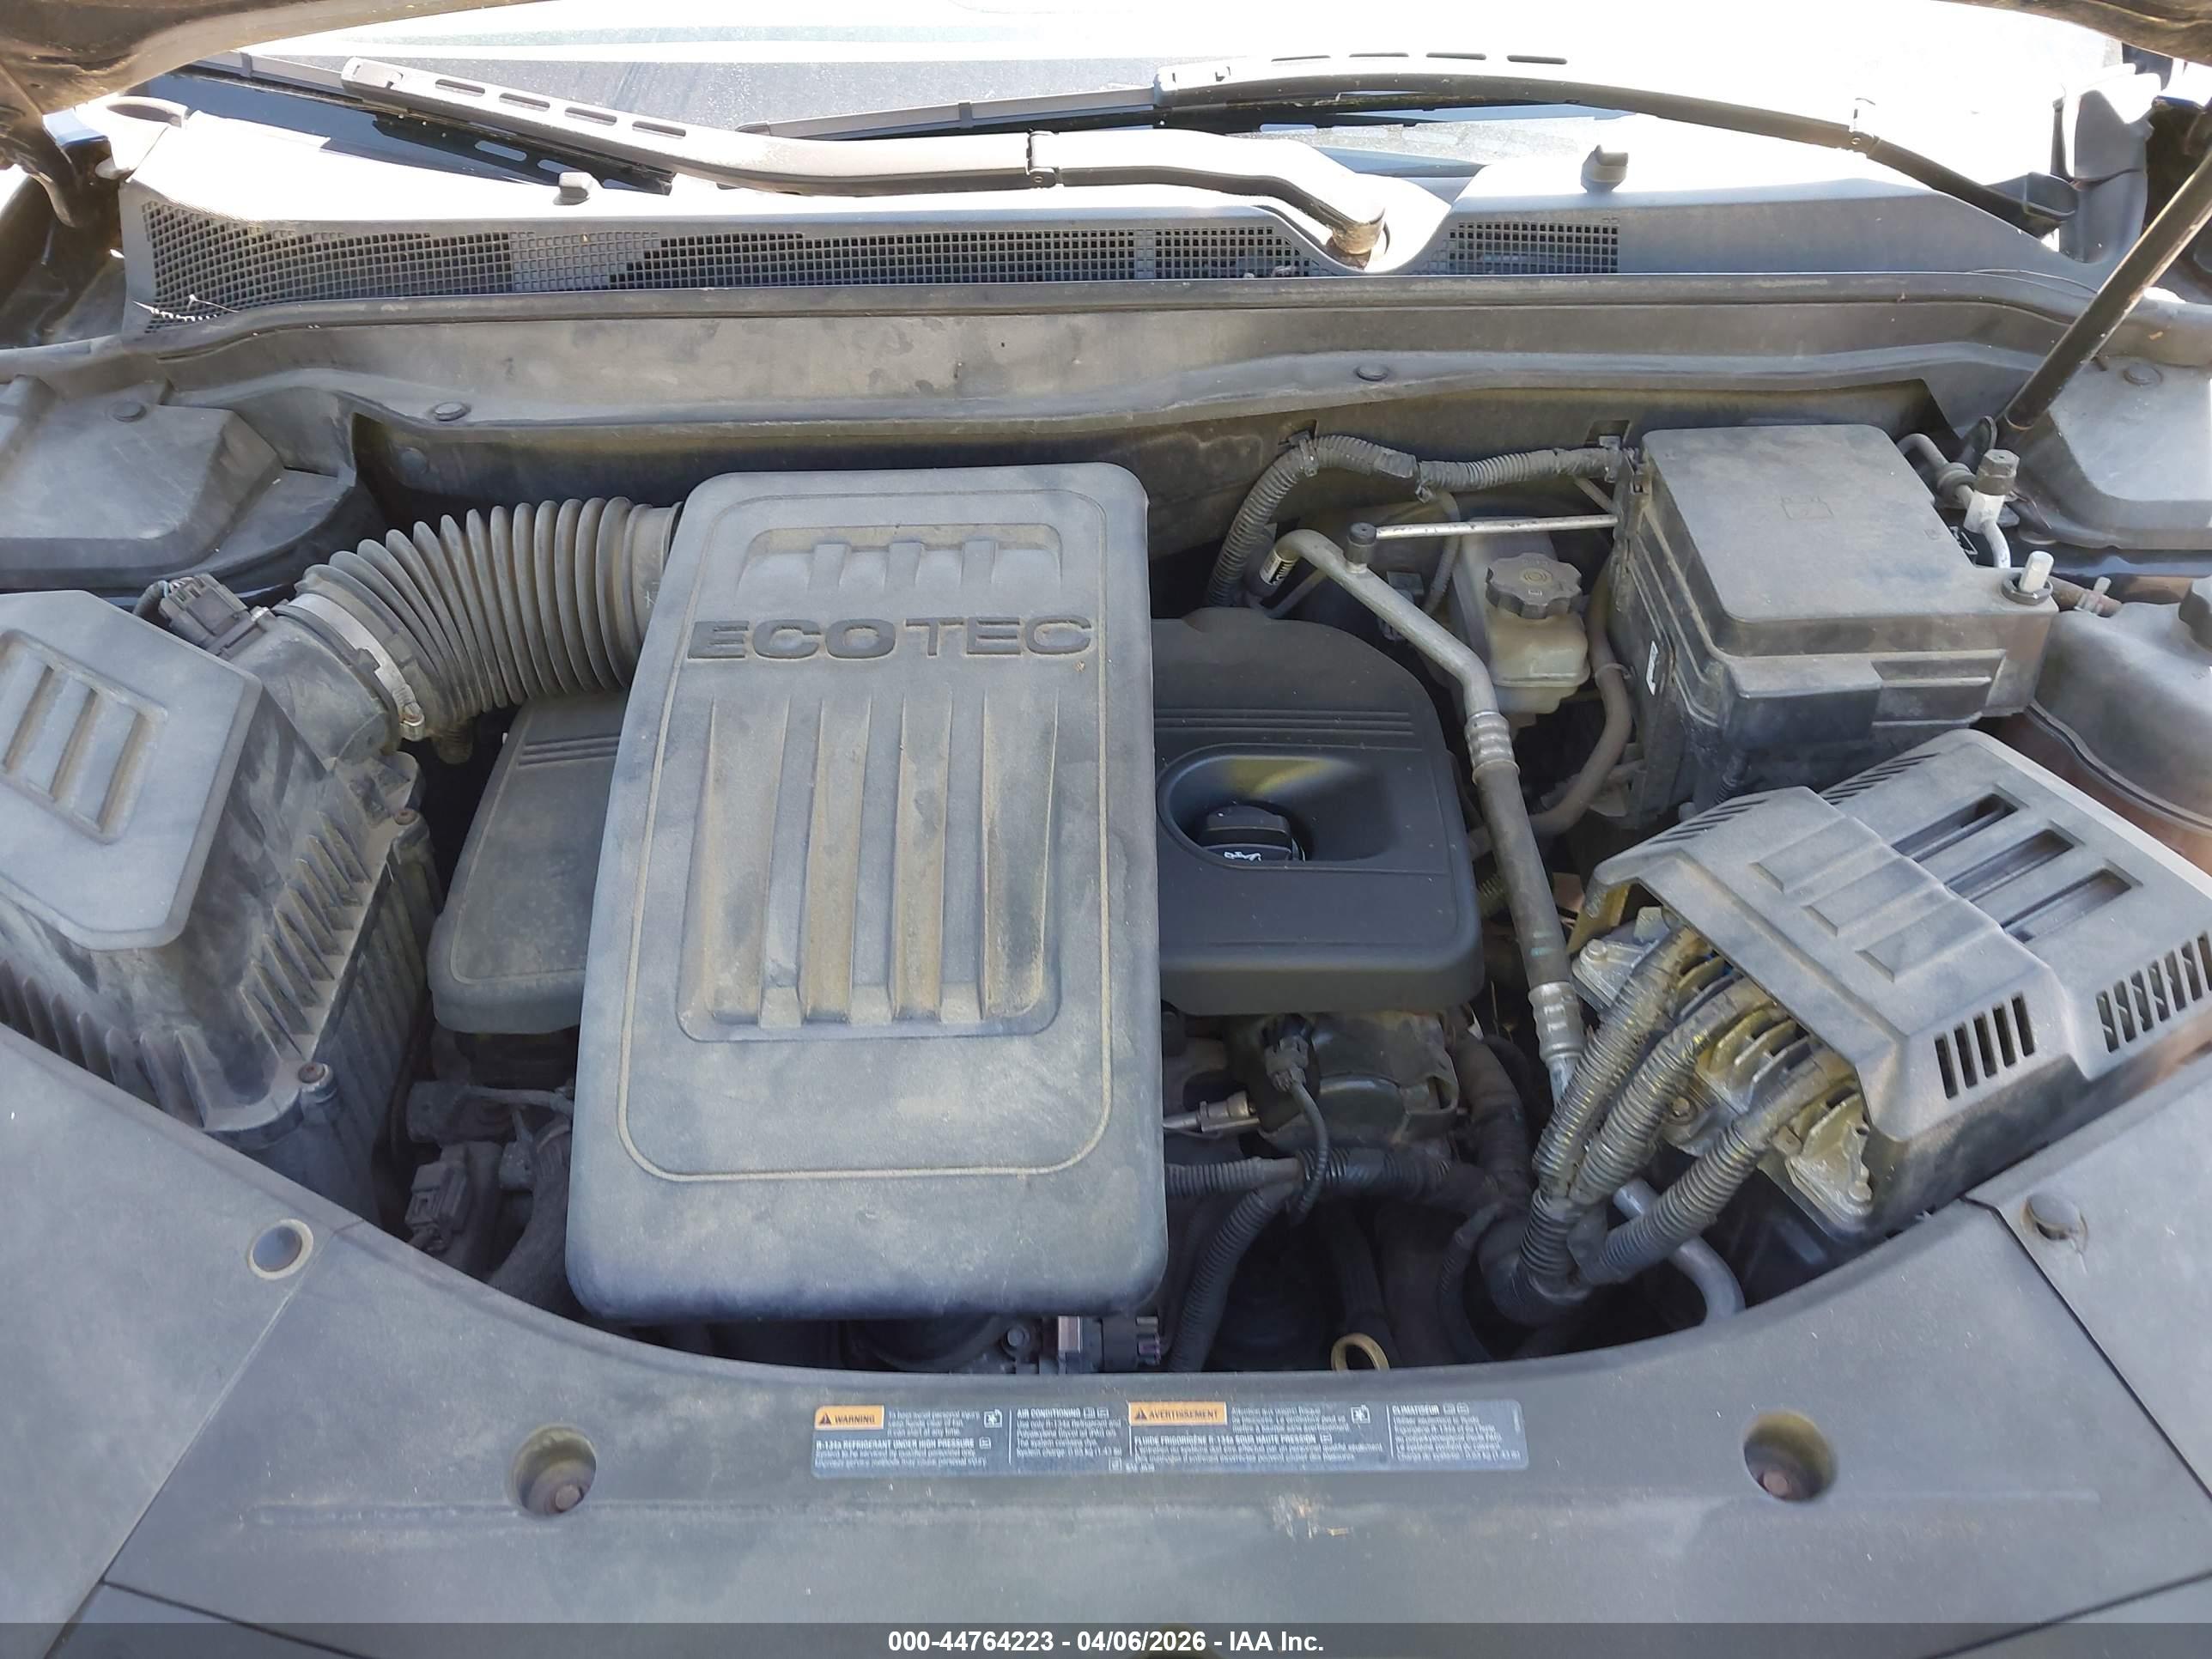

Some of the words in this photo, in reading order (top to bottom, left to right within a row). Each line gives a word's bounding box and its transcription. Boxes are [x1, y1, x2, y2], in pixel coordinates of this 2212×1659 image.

[687, 616, 1092, 659] ECOTEC
[1017, 1408, 1030, 1419] AIR
[1030, 1407, 1081, 1419] CONDITIONING
[1150, 1409, 1218, 1419] AVERTISSEMENT
[1392, 1405, 1440, 1416] CLIMATISEUR
[835, 1414, 875, 1425] WARNING
[842, 1438, 891, 1449] REFRIGERANT
[892, 1438, 918, 1449] UNDER
[918, 1438, 936, 1449] HIGH
[937, 1437, 975, 1449] PRESSURE
[1255, 1434, 1279, 1443] HAUTE
[1280, 1433, 1316, 1443] PRESSION
